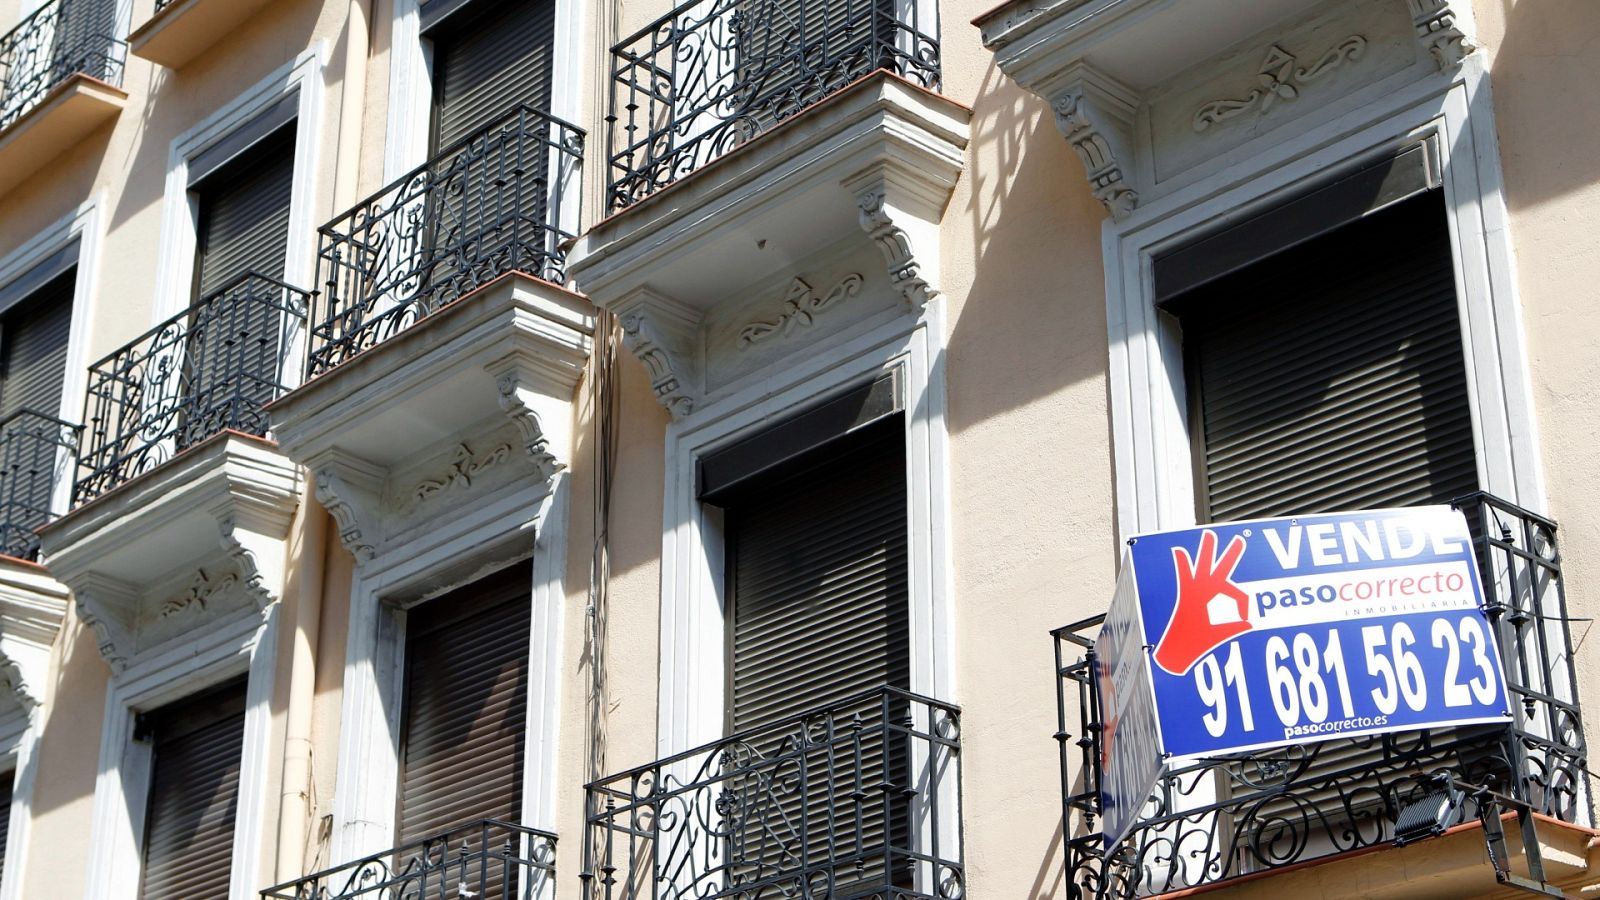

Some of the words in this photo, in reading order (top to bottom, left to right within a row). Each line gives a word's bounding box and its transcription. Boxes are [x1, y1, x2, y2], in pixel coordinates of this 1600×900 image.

[1262, 515, 1463, 570] VENDE
[1255, 571, 1464, 617] pasocorrecto
[1345, 599, 1469, 616] INMOBILIARIA
[1193, 641, 1254, 738] 91
[1265, 628, 1355, 727] 681
[1361, 622, 1427, 715] 56
[1431, 616, 1497, 707] 23
[1284, 714, 1388, 739] pasocorrecto.es
